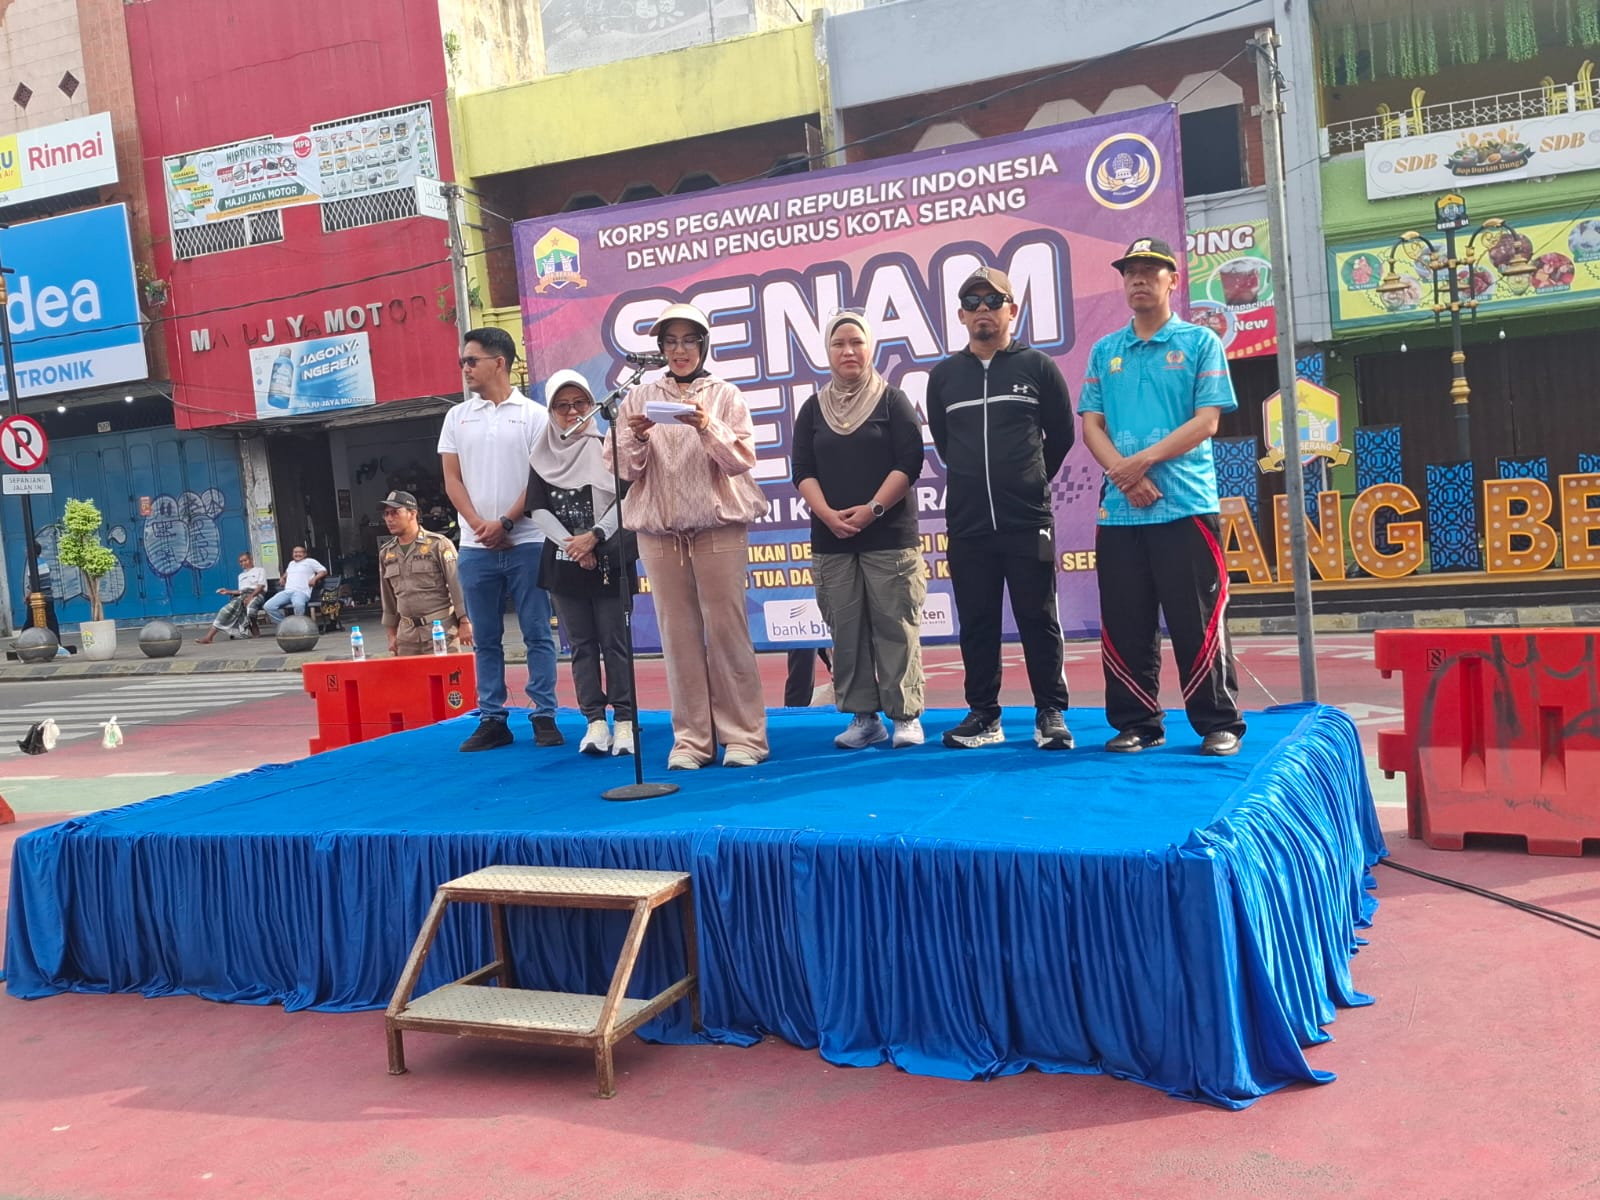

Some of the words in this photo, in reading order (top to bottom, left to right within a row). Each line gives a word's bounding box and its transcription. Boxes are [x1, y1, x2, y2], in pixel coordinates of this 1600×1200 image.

[28, 131, 103, 171] Rinnai
[1539, 131, 1586, 154] SDB
[1394, 152, 1438, 174] SDB
[224, 194, 246, 208] MAJU
[247, 191, 267, 204] JAYA
[267, 185, 298, 199] MOTOR
[598, 219, 669, 248] KORPS
[675, 201, 779, 236] PEGAWAI
[786, 179, 905, 217] REPUBLIK
[911, 152, 1059, 195] INDONESIA
[626, 241, 708, 271] DEWAN
[715, 218, 840, 256] PENGURUS
[845, 208, 912, 236] KOTA
[919, 187, 1026, 223] SERANG
[7, 275, 101, 335] dea
[1233, 318, 1269, 333] New
[300, 338, 361, 367] JAGONYA
[303, 353, 360, 381] NGEREM
[1220, 482, 1424, 585] ANG
[753, 569, 786, 588] TUA
[772, 621, 806, 636] bank
